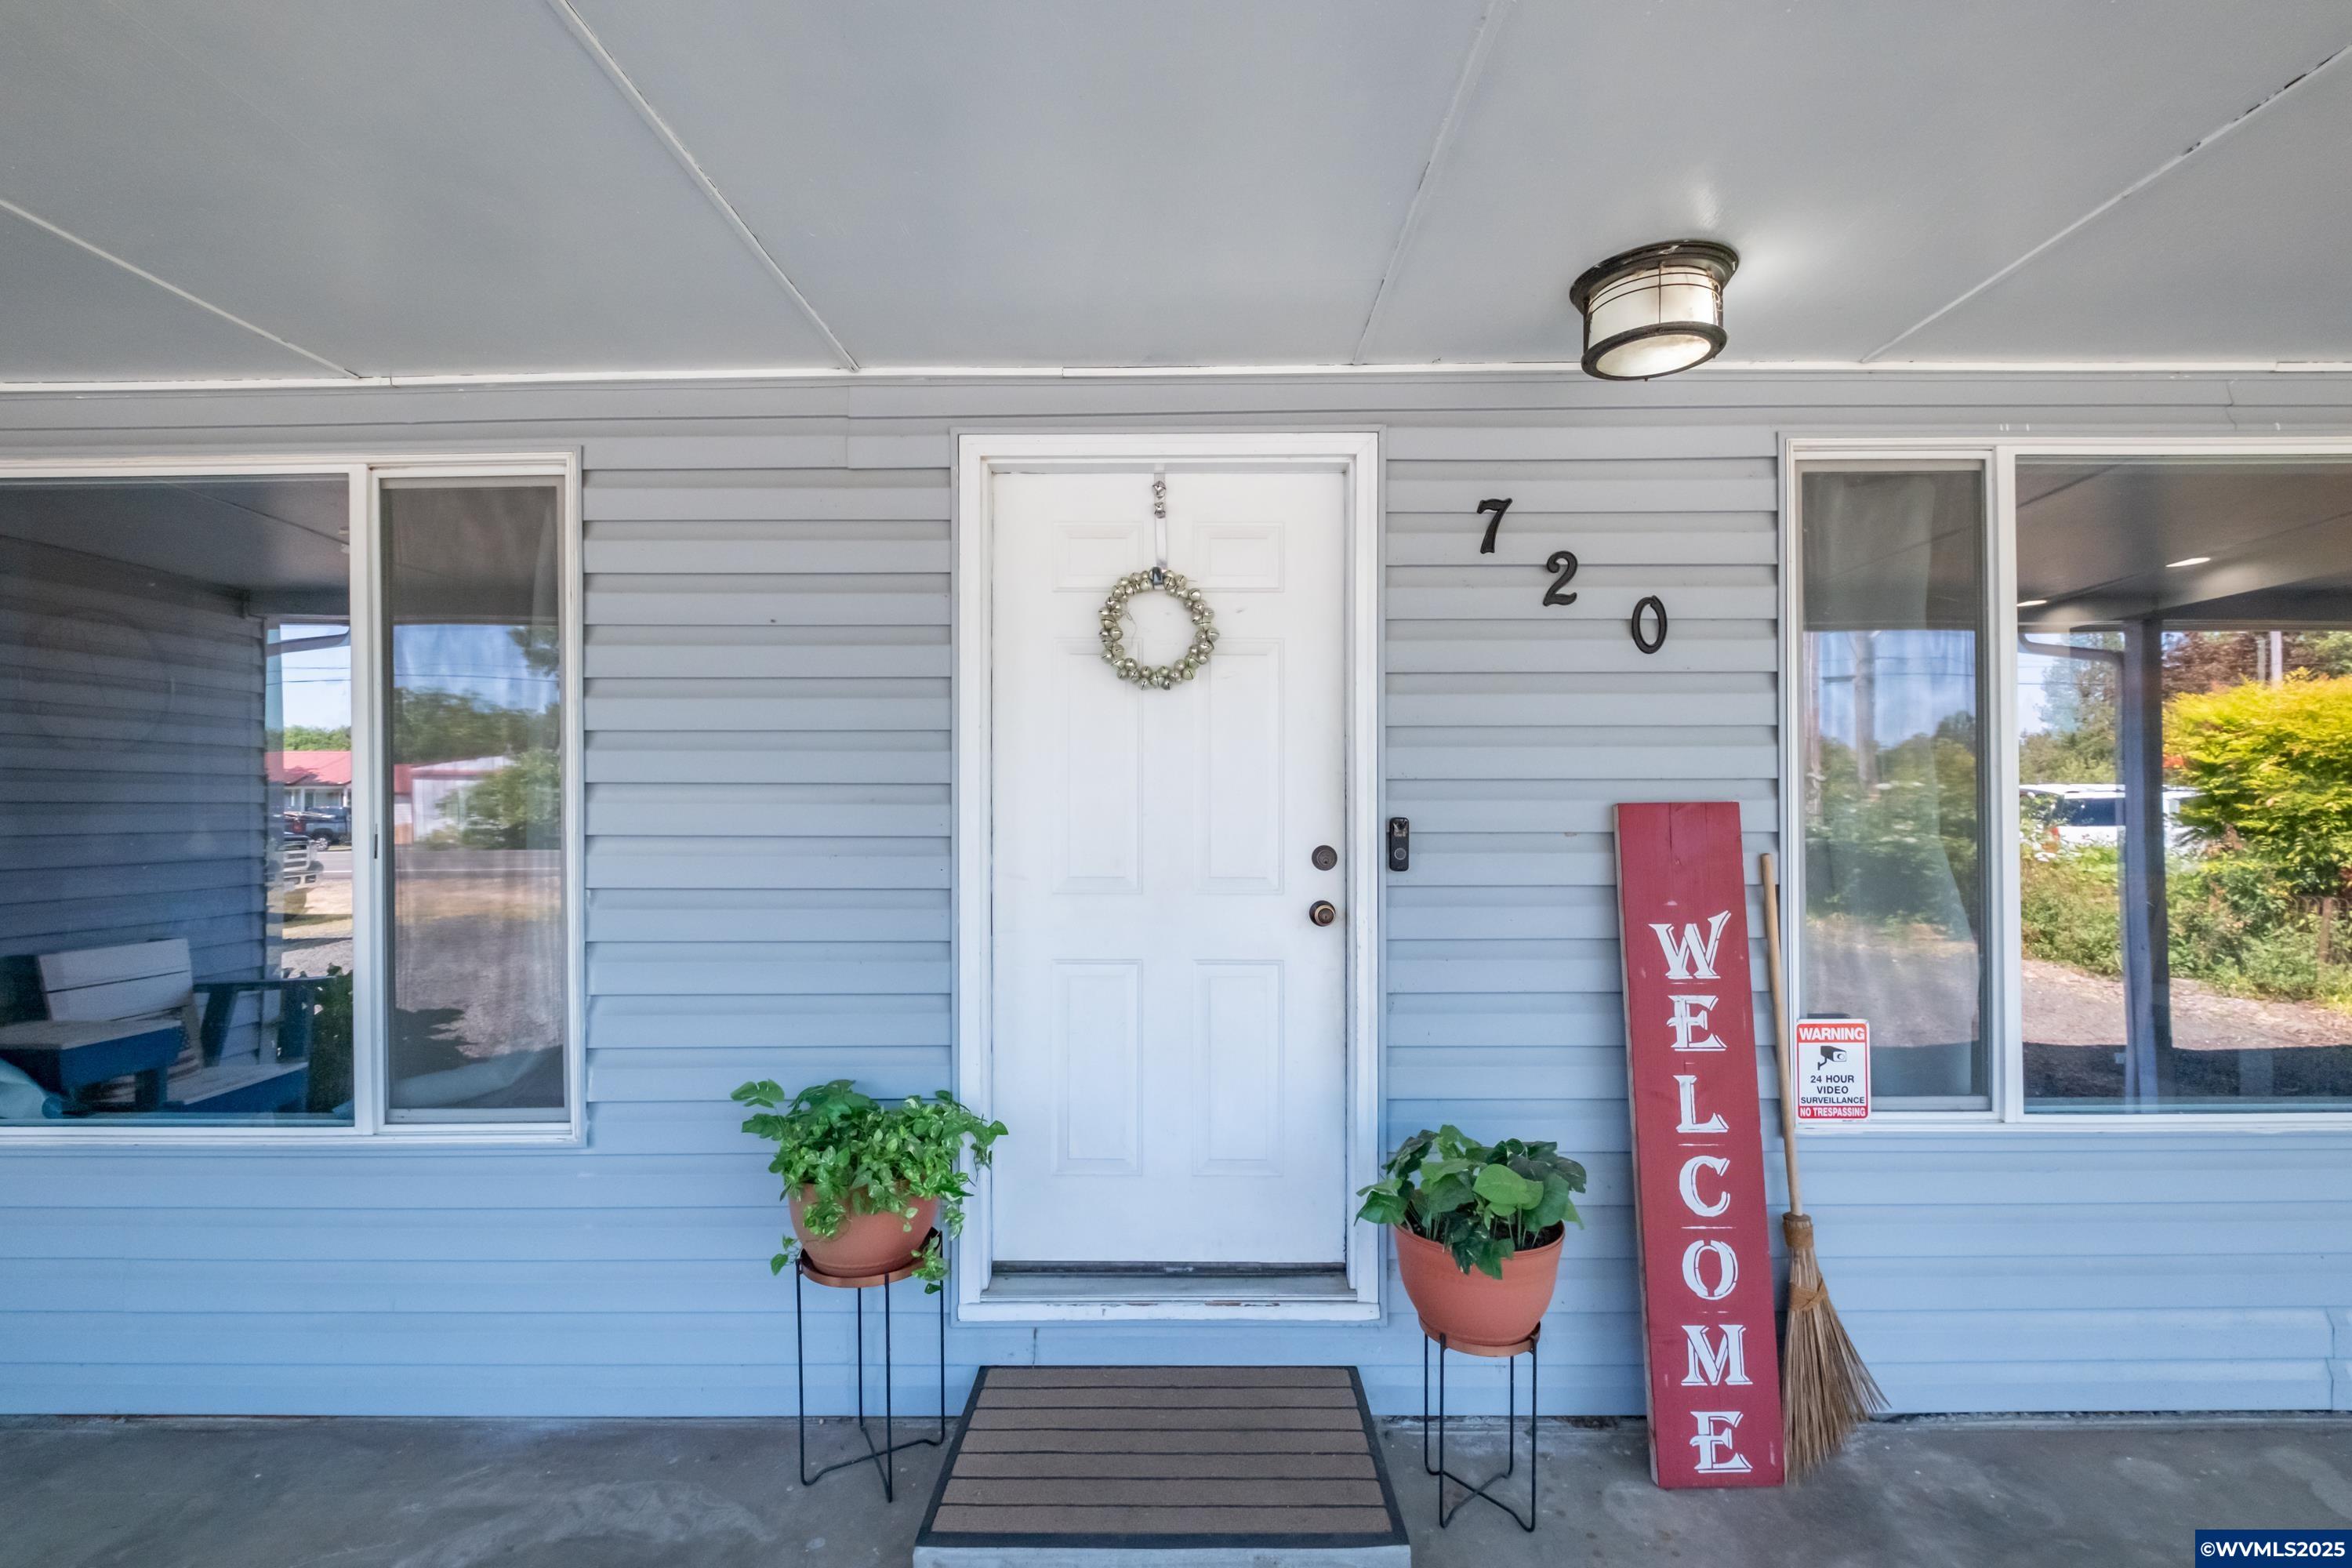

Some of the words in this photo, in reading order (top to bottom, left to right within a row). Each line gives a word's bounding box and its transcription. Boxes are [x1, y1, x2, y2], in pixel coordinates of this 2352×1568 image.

[1476, 498, 1668, 654] 720
[1799, 1028, 1865, 1040] WARNING
[1826, 1075, 1855, 1083] HOUR
[1817, 1086, 1849, 1094] VIDEO
[1800, 1108, 1812, 1116] NO
[1813, 1107, 1866, 1117] TRESPASSING
[1648, 909, 1753, 1474] WELCOME
